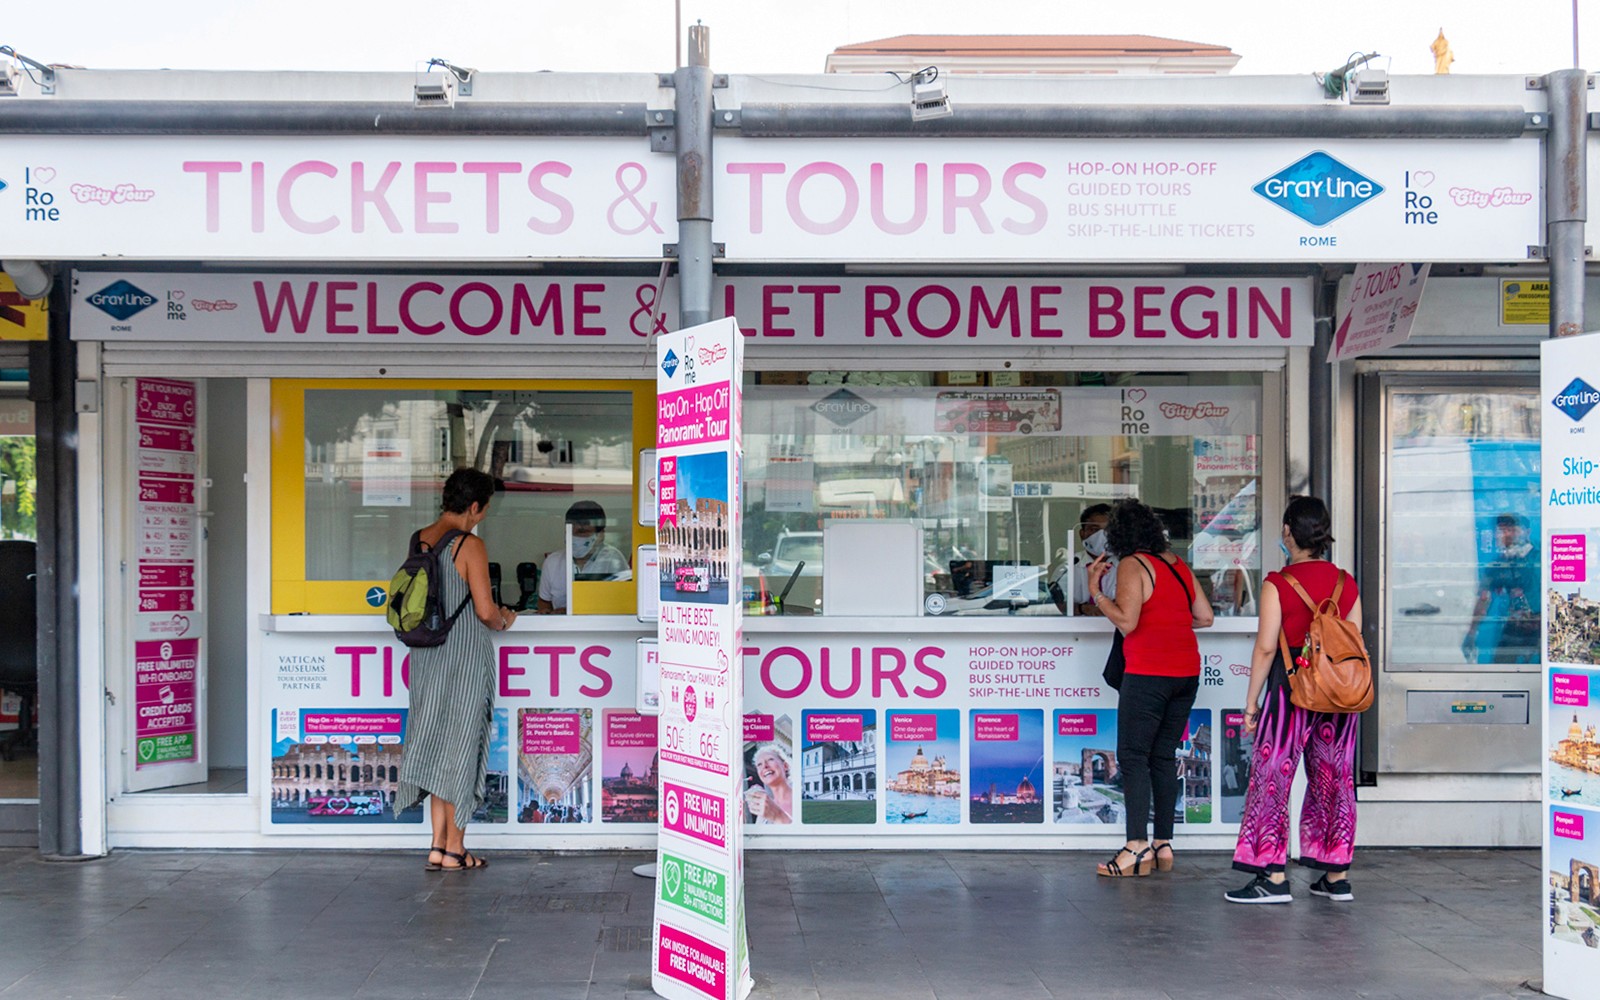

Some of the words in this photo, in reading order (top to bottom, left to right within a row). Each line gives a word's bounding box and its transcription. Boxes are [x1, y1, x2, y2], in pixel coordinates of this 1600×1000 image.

[1068, 162, 1137, 175] HOP-ON
[1143, 162, 1217, 175] HOP-OFF
[26, 187, 54, 205] Ro
[70, 184, 113, 205] City
[112, 184, 155, 204] Tour
[1068, 183, 1131, 196] GUIDED
[1137, 183, 1191, 196] TOURS
[183, 161, 574, 235] TICKETS
[607, 162, 664, 235] &
[726, 161, 1048, 235] TOURS
[1405, 192, 1432, 208] Ro
[1449, 187, 1492, 208] City
[1490, 187, 1532, 206] Tour
[26, 207, 60, 221] me
[1068, 203, 1099, 216] BUS
[1104, 203, 1177, 216] SHUTTLE
[1405, 211, 1438, 224] me
[1067, 224, 1184, 237] SKIP-THE-LINE
[1189, 224, 1255, 237] TICKETS
[1300, 237, 1337, 246] ROME
[1363, 262, 1405, 299] TOURS
[168, 302, 183, 312] Ro
[252, 281, 606, 336] WELCOME
[629, 284, 669, 337] &
[725, 285, 841, 337] LET
[865, 285, 1062, 338] ROME
[1089, 286, 1291, 339] BEGIN
[685, 371, 696, 384] me
[659, 398, 676, 422] Hop
[676, 396, 689, 417] On
[695, 392, 713, 416] Hop
[714, 387, 729, 410] Off
[1160, 402, 1194, 420] City
[1192, 402, 1229, 418] Tour
[1122, 406, 1145, 421] Ro
[658, 417, 704, 444] Panoramic
[705, 415, 728, 437] Tour
[1122, 422, 1150, 434] me
[663, 461, 674, 472] TOP
[1197, 463, 1238, 471] Panoramic
[1240, 462, 1258, 471] Tour
[661, 487, 675, 500] BEST
[660, 502, 676, 515] PRICE
[661, 606, 675, 623] ALL
[676, 607, 692, 625] THE
[666, 627, 691, 644] SAVING
[969, 647, 1018, 657] HOP-ON
[1021, 647, 1074, 657] HOP-OFF
[138, 661, 155, 671] FREE
[156, 659, 194, 670] UNLIMITED
[969, 660, 1013, 670] GUIDED
[1017, 660, 1056, 670] TOURS
[139, 672, 156, 683] WI-FI
[158, 671, 193, 682] ONBOARD
[1204, 667, 1220, 677] Ro
[969, 674, 991, 684] BUS
[995, 674, 1045, 684] SHUTTLE
[1204, 678, 1224, 686] me
[969, 688, 1050, 697] SKIP-THE-LINE
[1054, 688, 1100, 697] TICKETS
[140, 705, 167, 717] CREDIT
[168, 702, 192, 714] CARDS
[147, 716, 185, 728] ACCEPTED
[156, 736, 173, 746] FREE
[174, 735, 188, 745] APP
[666, 724, 685, 752] 50€
[700, 732, 720, 761] 66€
[684, 791, 700, 813] FREE
[701, 796, 720, 818] WI-FI
[684, 811, 726, 842] UNLIMITED!
[684, 863, 702, 886] FREE
[702, 869, 718, 891] APP
[661, 936, 671, 951] ASK
[671, 940, 689, 957] INSIDE
[690, 947, 700, 962] FOR
[701, 952, 725, 974] AVAILABLE
[670, 953, 686, 973] FREE
[687, 960, 716, 987] UPGRADE
